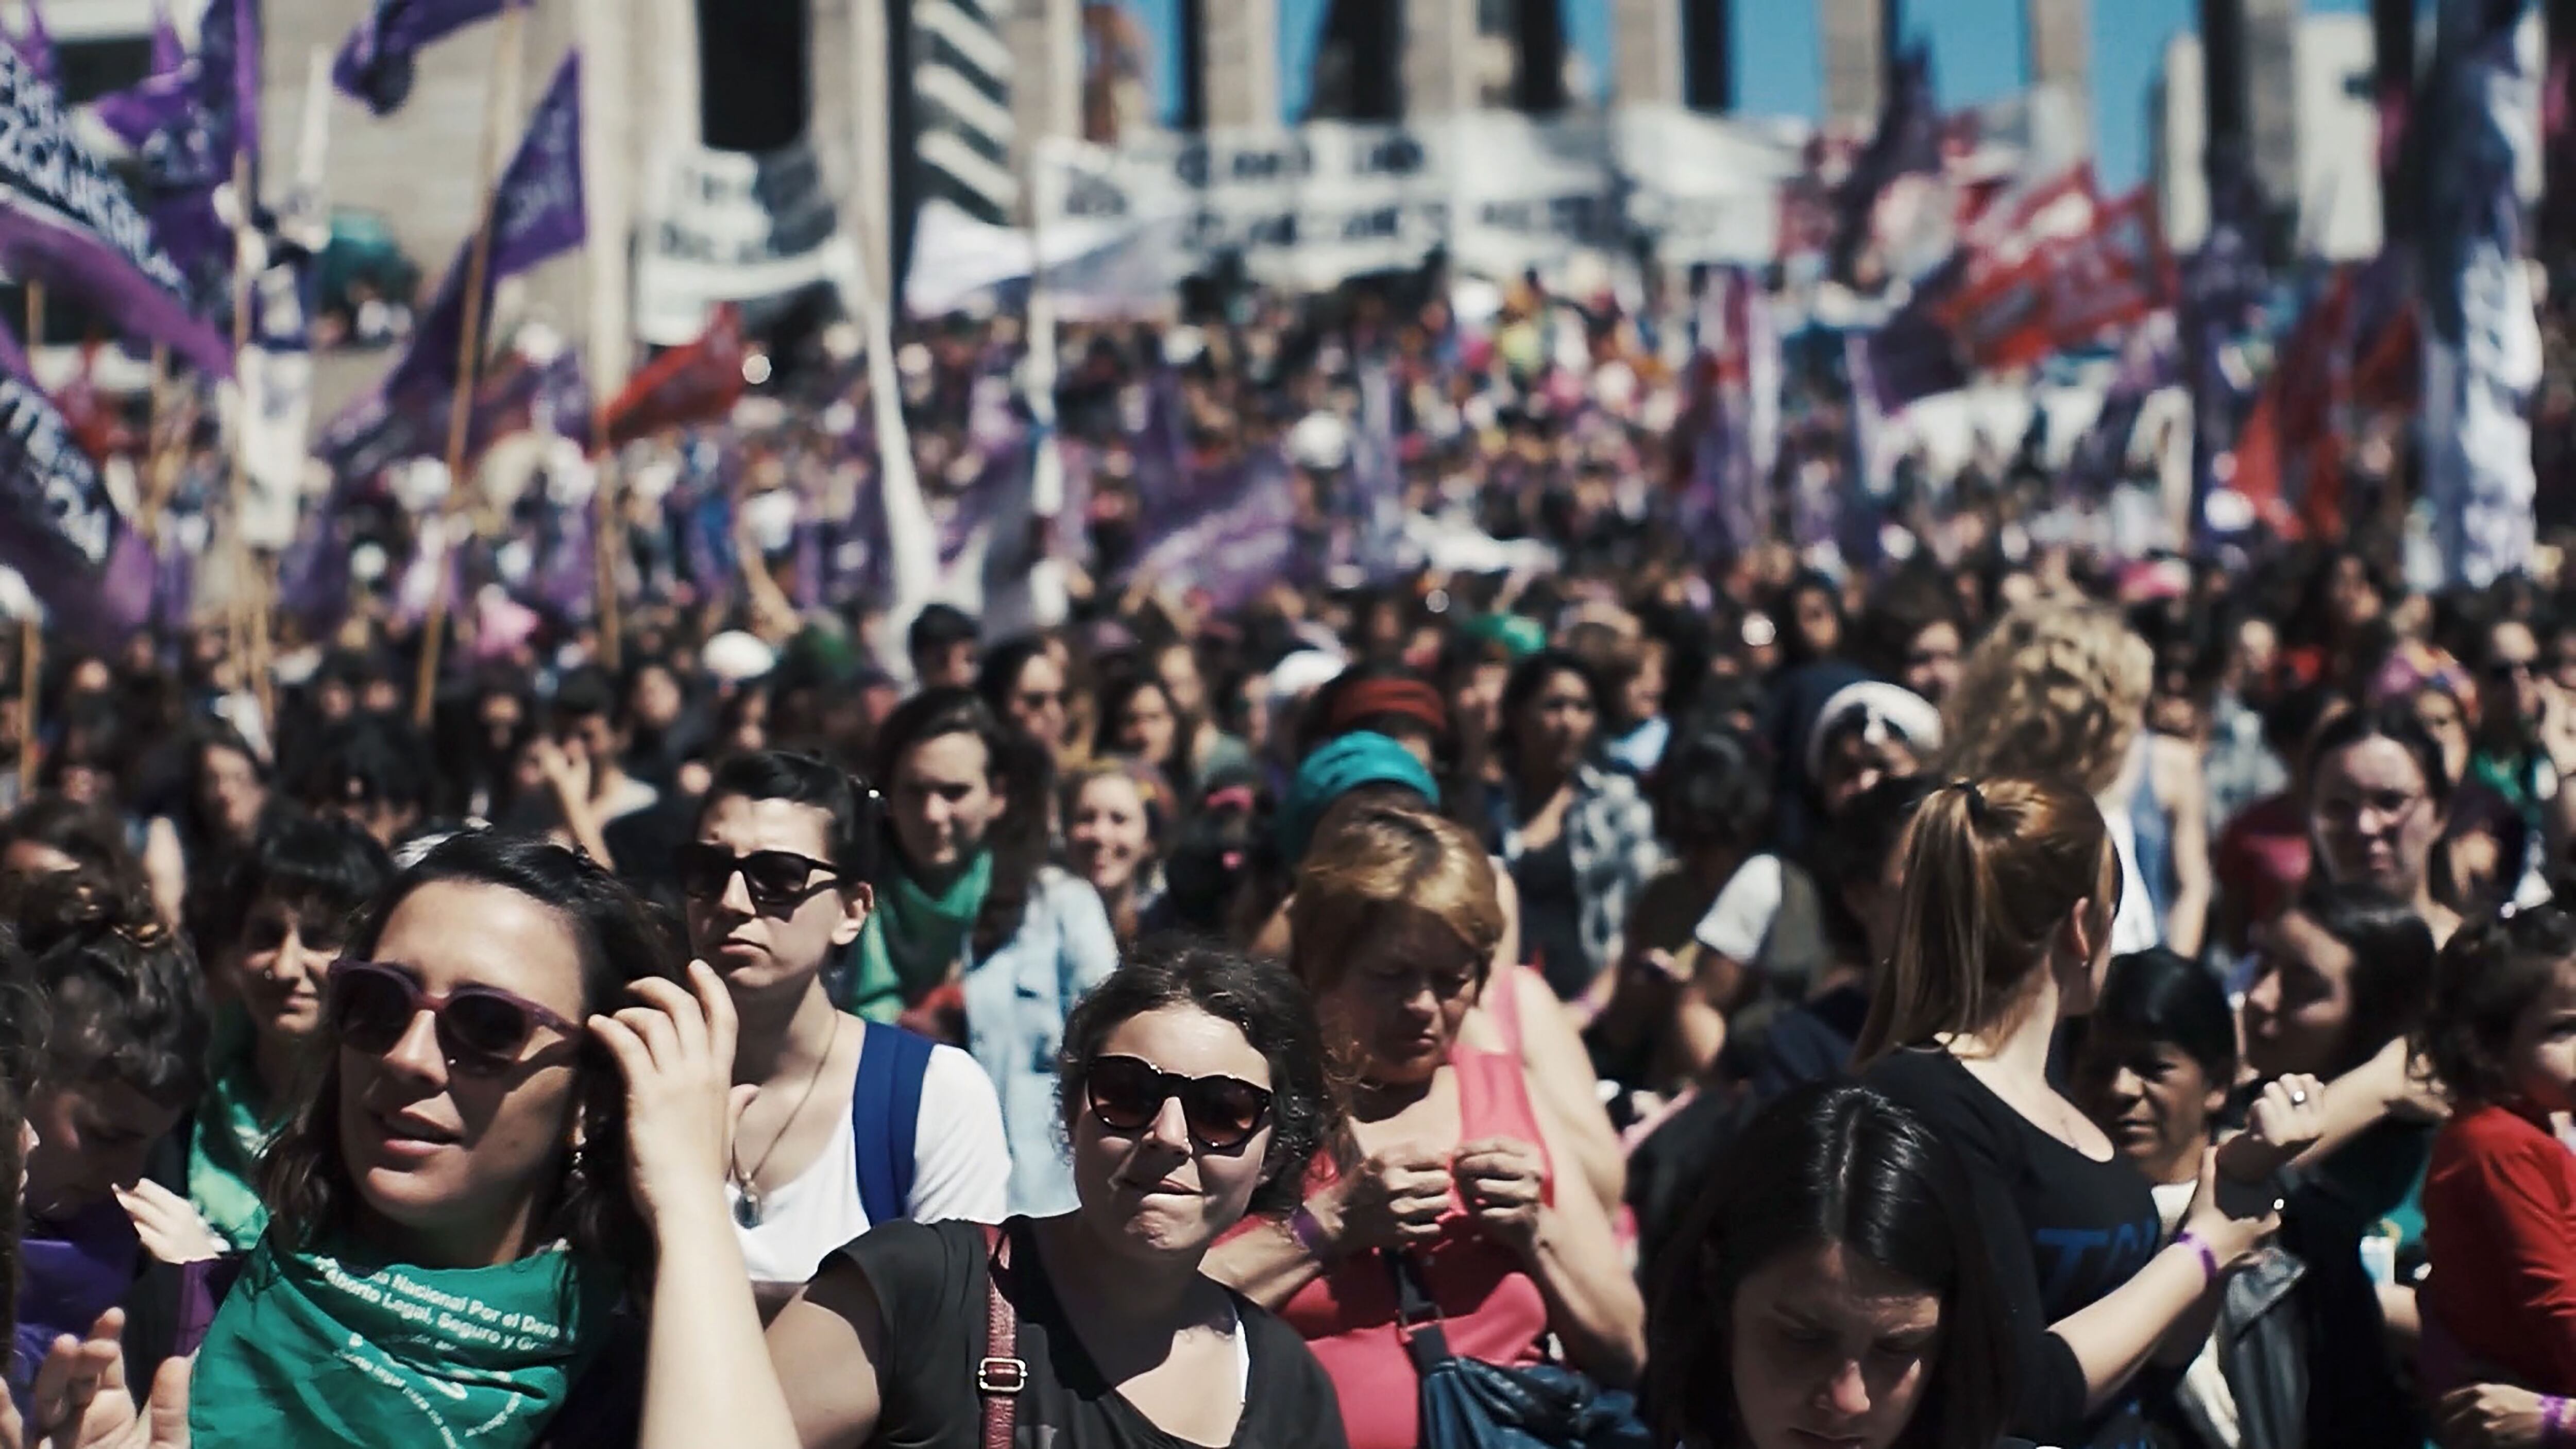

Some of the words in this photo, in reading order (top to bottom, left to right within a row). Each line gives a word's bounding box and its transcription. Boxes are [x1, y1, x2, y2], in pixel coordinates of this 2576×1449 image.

[391, 1274, 468, 1312] Nacional
[468, 1300, 502, 1322] Por
[502, 1313, 520, 1328] el
[438, 1312, 501, 1343] Seguro
[501, 1335, 515, 1349] y
